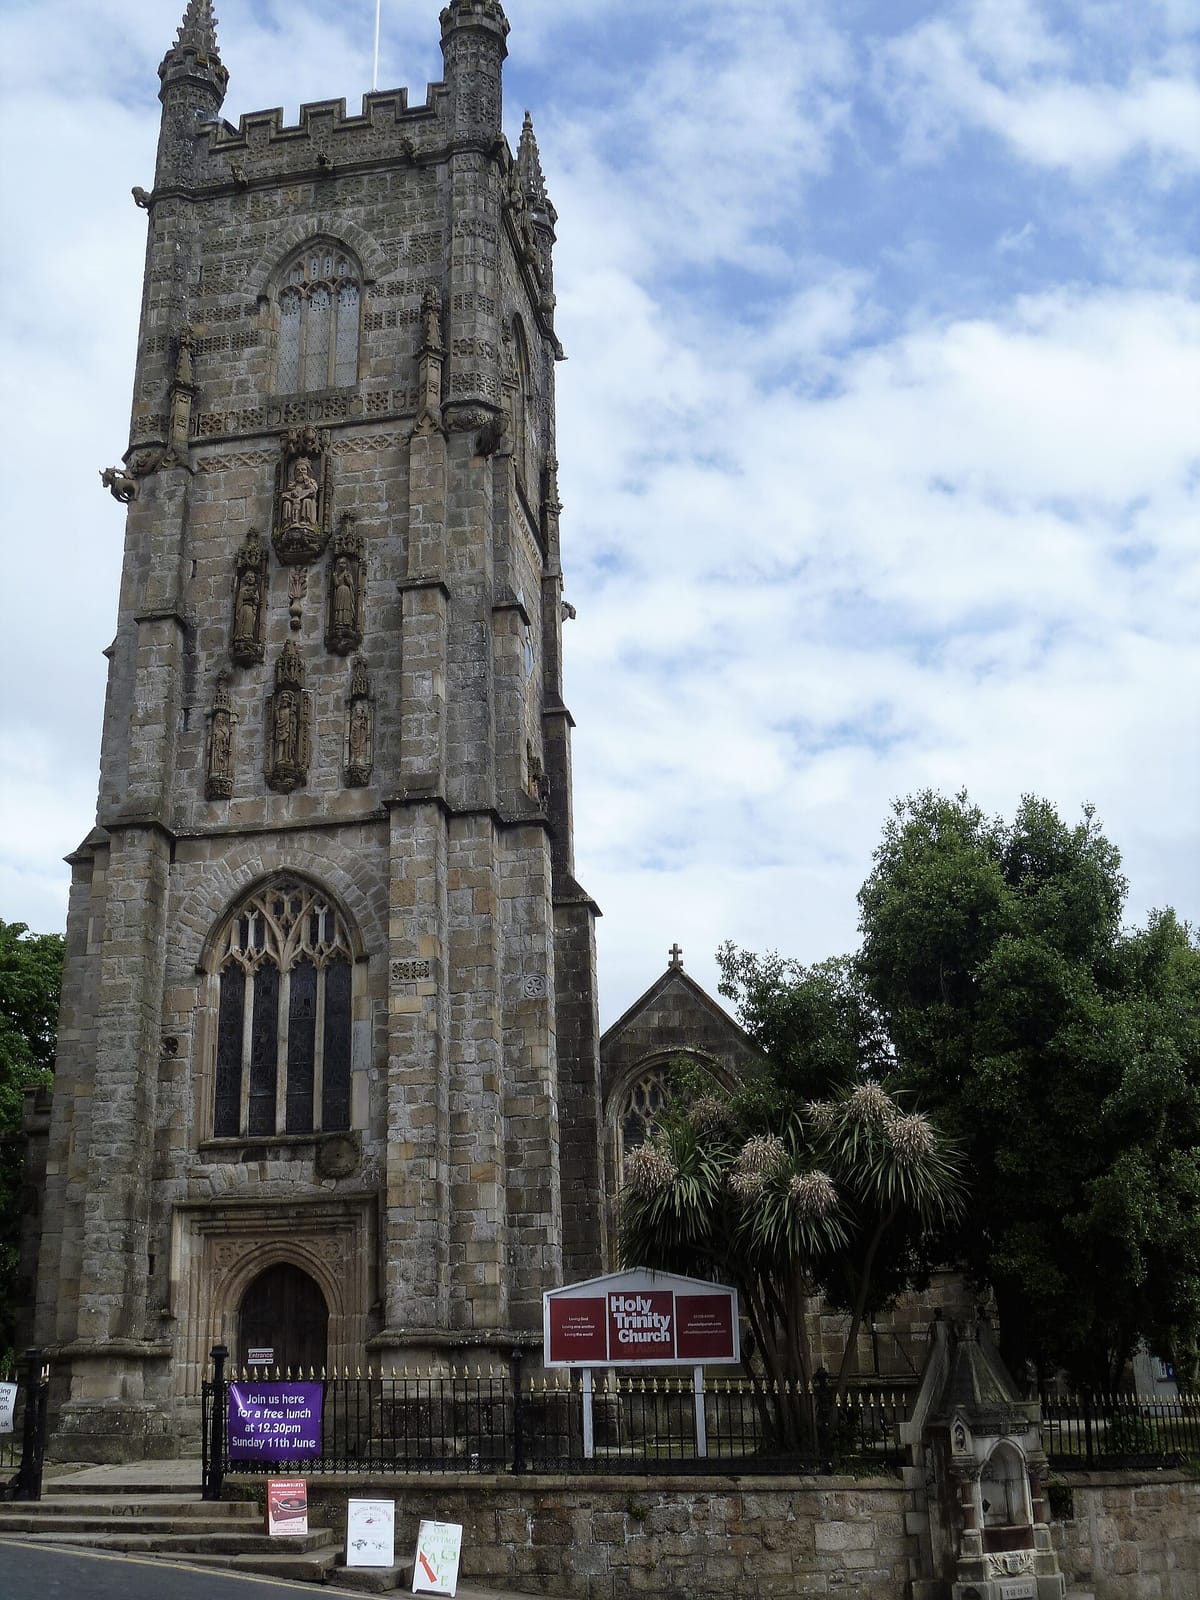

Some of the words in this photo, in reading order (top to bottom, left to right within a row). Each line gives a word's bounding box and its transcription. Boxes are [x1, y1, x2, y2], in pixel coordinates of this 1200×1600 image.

[611, 1296, 652, 1314] Holy
[614, 1312, 670, 1330] Trinity
[618, 1328, 670, 1342] Church
[247, 1394, 266, 1404] Join
[268, 1396, 279, 1404] us
[282, 1394, 305, 1404] here
[238, 1408, 252, 1418] for
[263, 1409, 283, 1419] free
[286, 1408, 311, 1419] lunch
[244, 1423, 255, 1432] at
[257, 1423, 301, 1434] 12.30pm
[232, 1437, 265, 1449] Sunday
[267, 1437, 290, 1448] 11th
[292, 1437, 316, 1448] June
